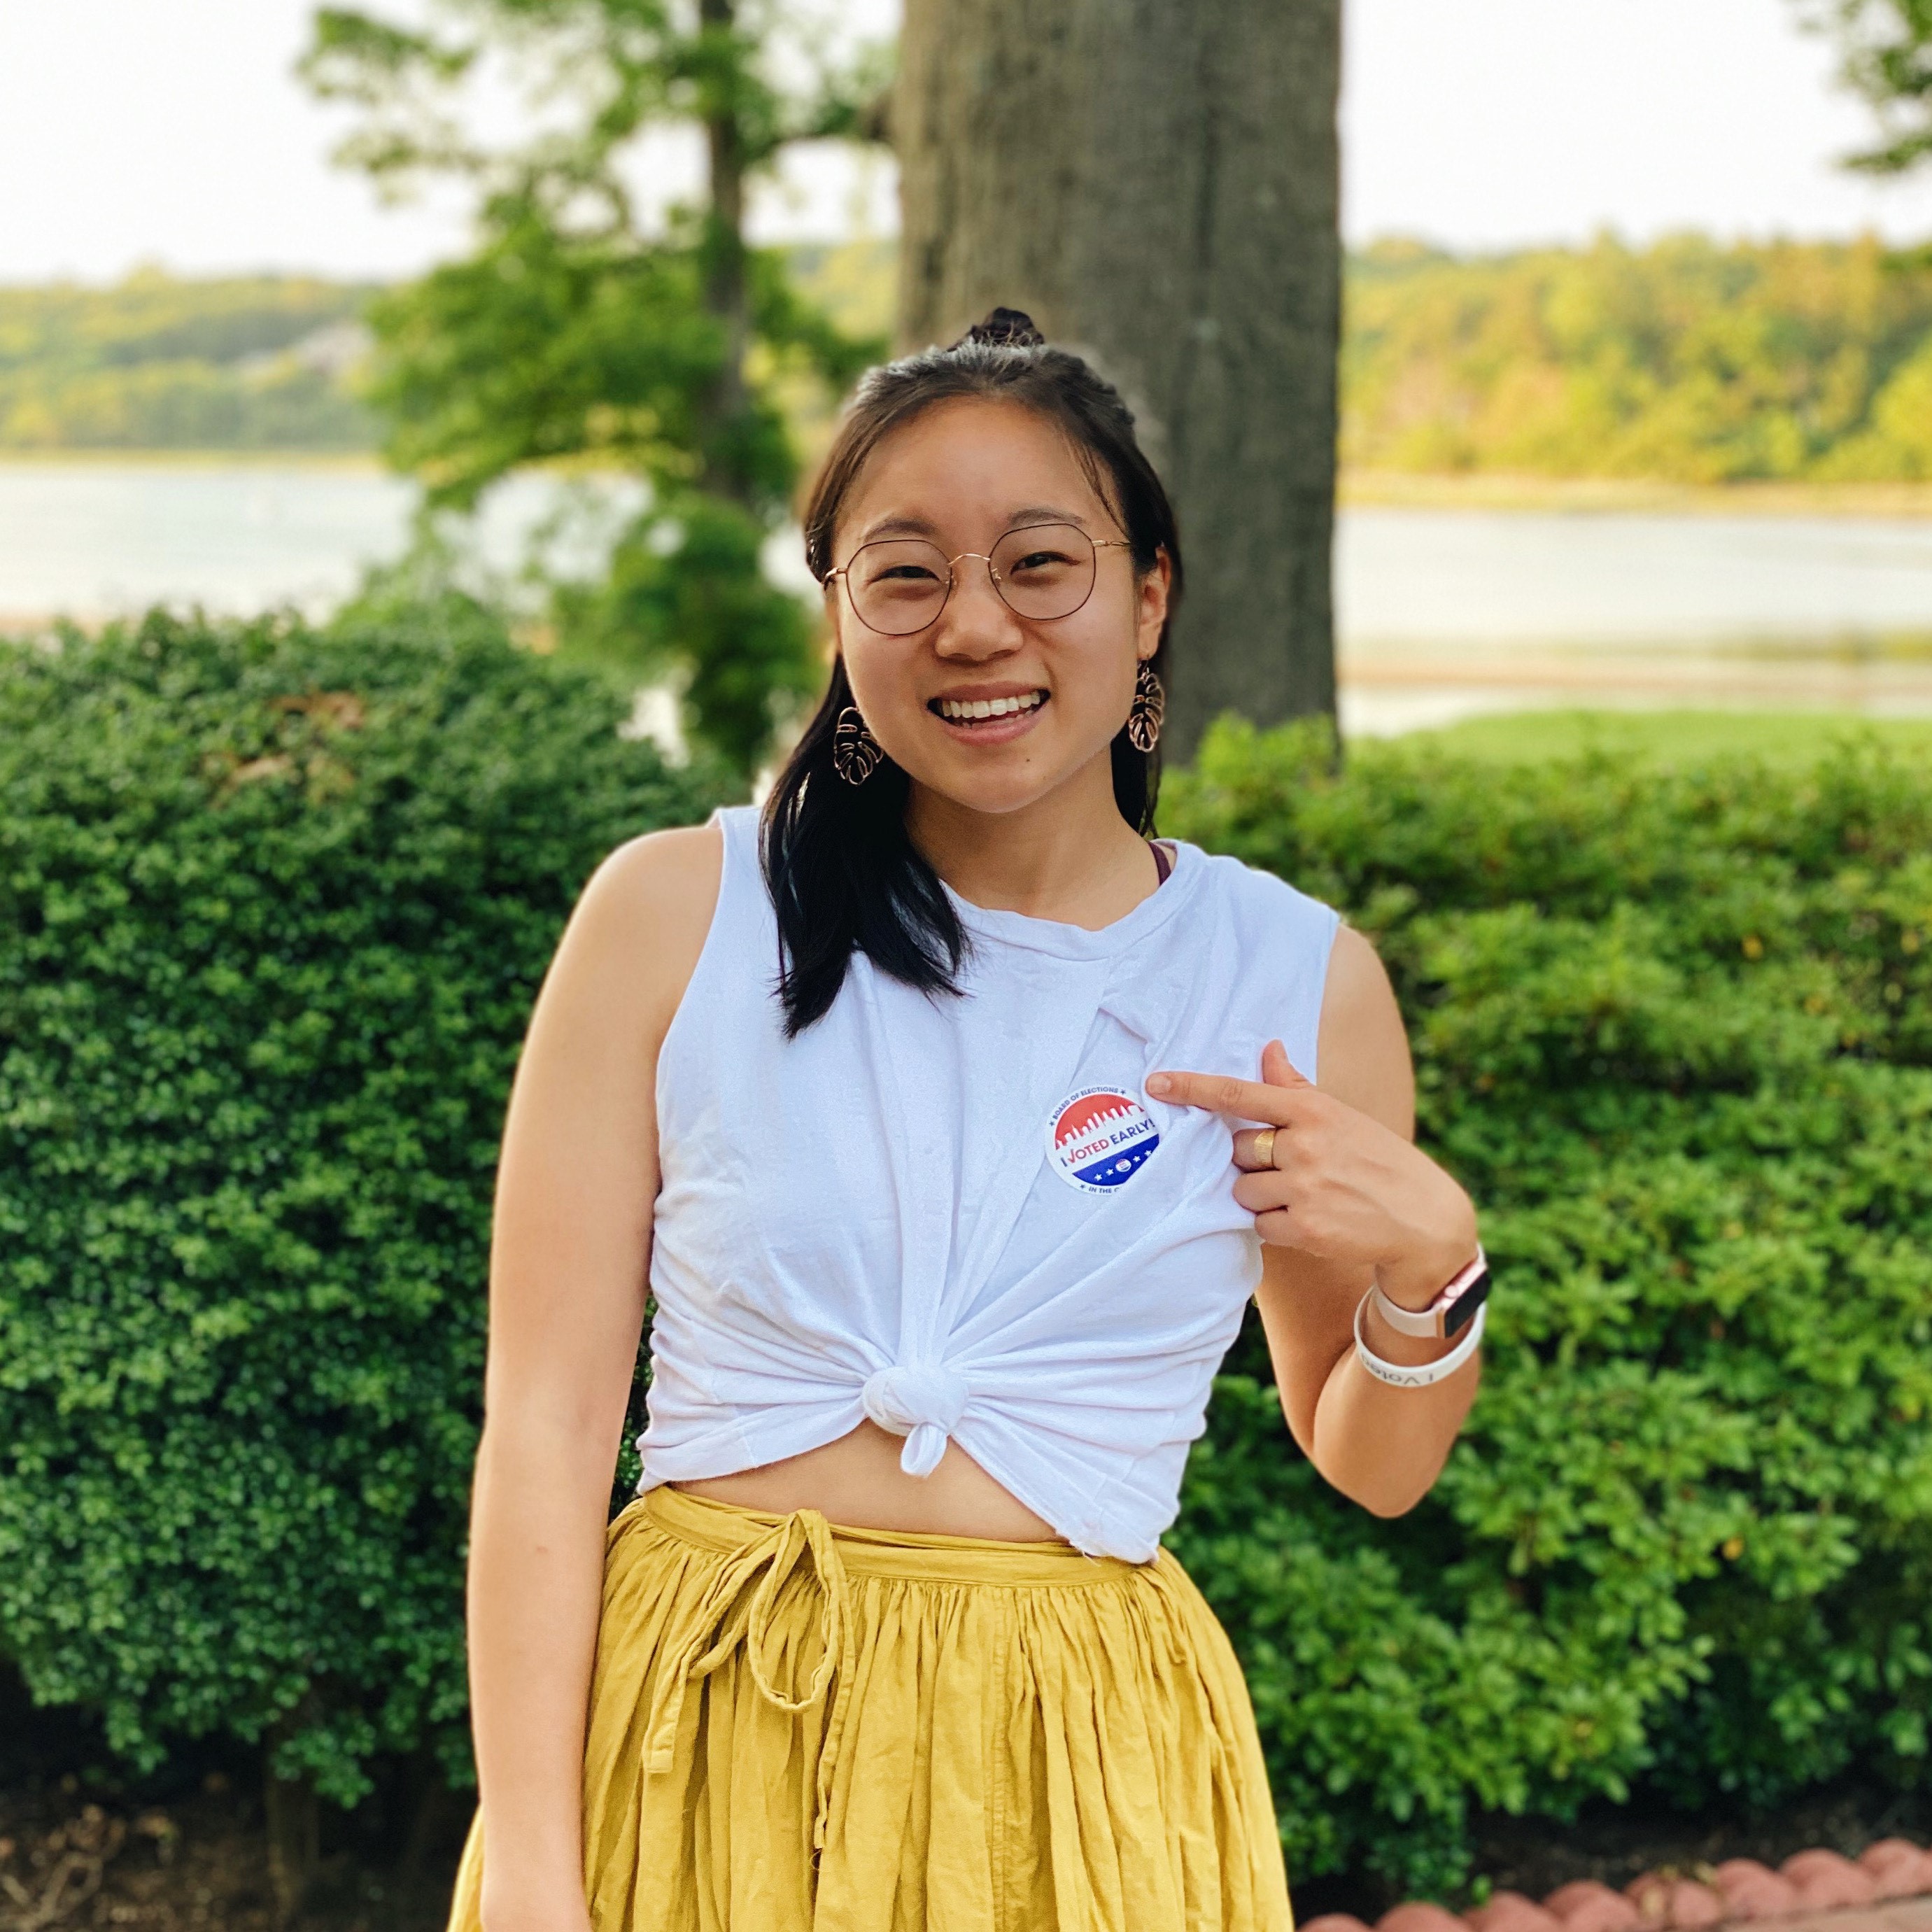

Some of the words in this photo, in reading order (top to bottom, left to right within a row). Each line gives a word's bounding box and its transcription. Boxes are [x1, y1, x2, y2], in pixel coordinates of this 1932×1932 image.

[1053, 1100, 1070, 1119] BOARD
[1071, 1092, 1079, 1101] OF
[1080, 1086, 1118, 1097] ELECTIONS
[1060, 1157, 1068, 1167] I
[1068, 1139, 1109, 1163] VOTED
[1109, 1118, 1155, 1144] EARLY!
